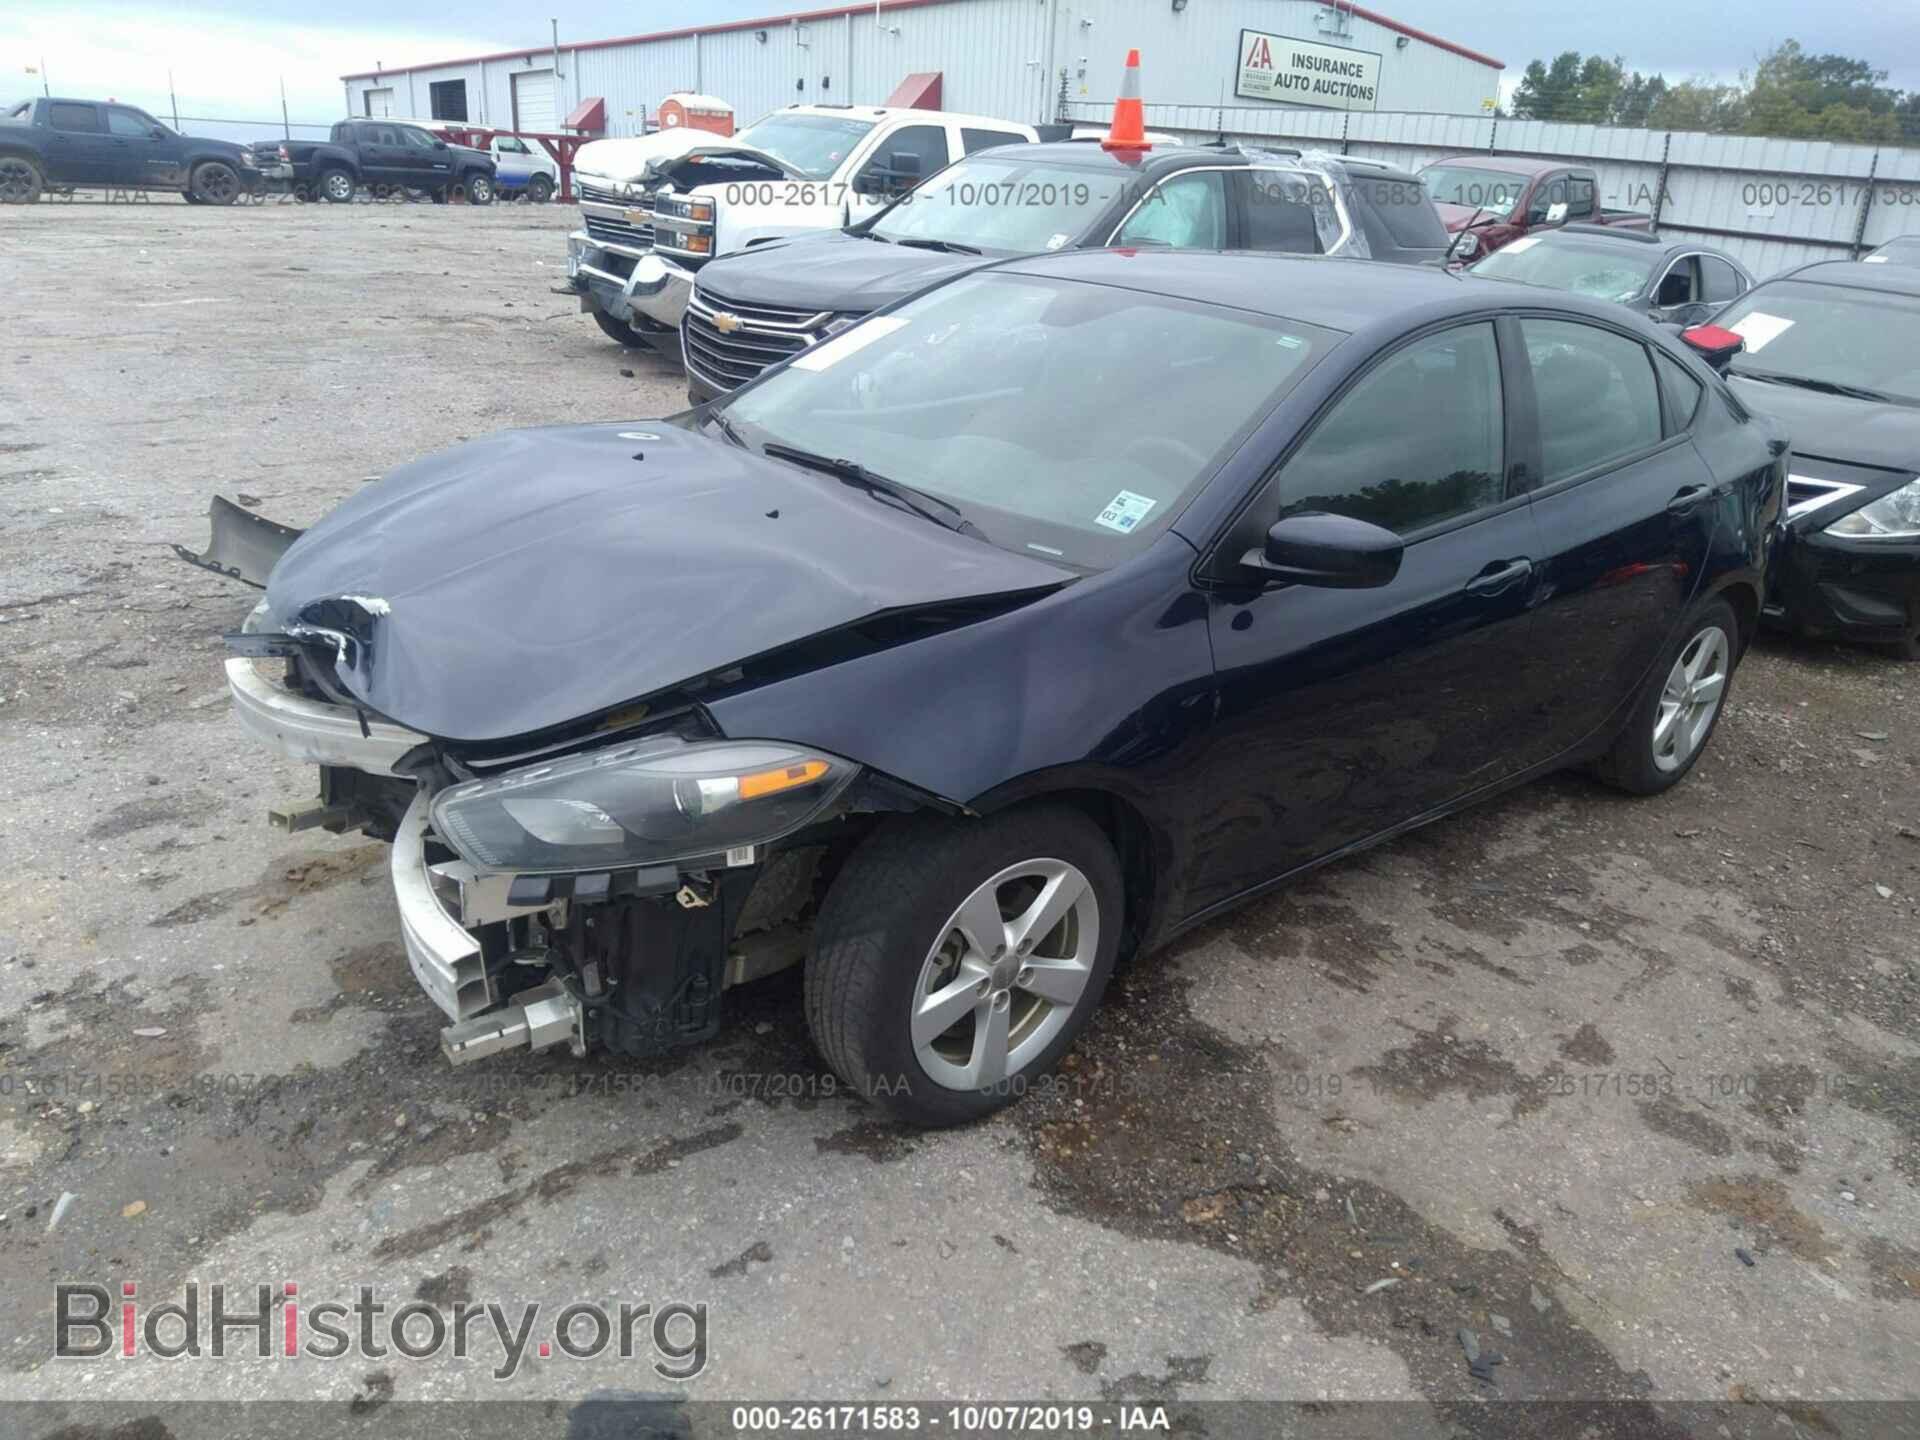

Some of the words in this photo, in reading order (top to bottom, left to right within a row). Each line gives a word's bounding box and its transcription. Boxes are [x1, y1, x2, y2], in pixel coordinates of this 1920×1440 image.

[1291, 53, 1363, 78] INSURANCE
[1274, 73, 1310, 90] AUTO
[1313, 78, 1374, 101] AUCTIONS
